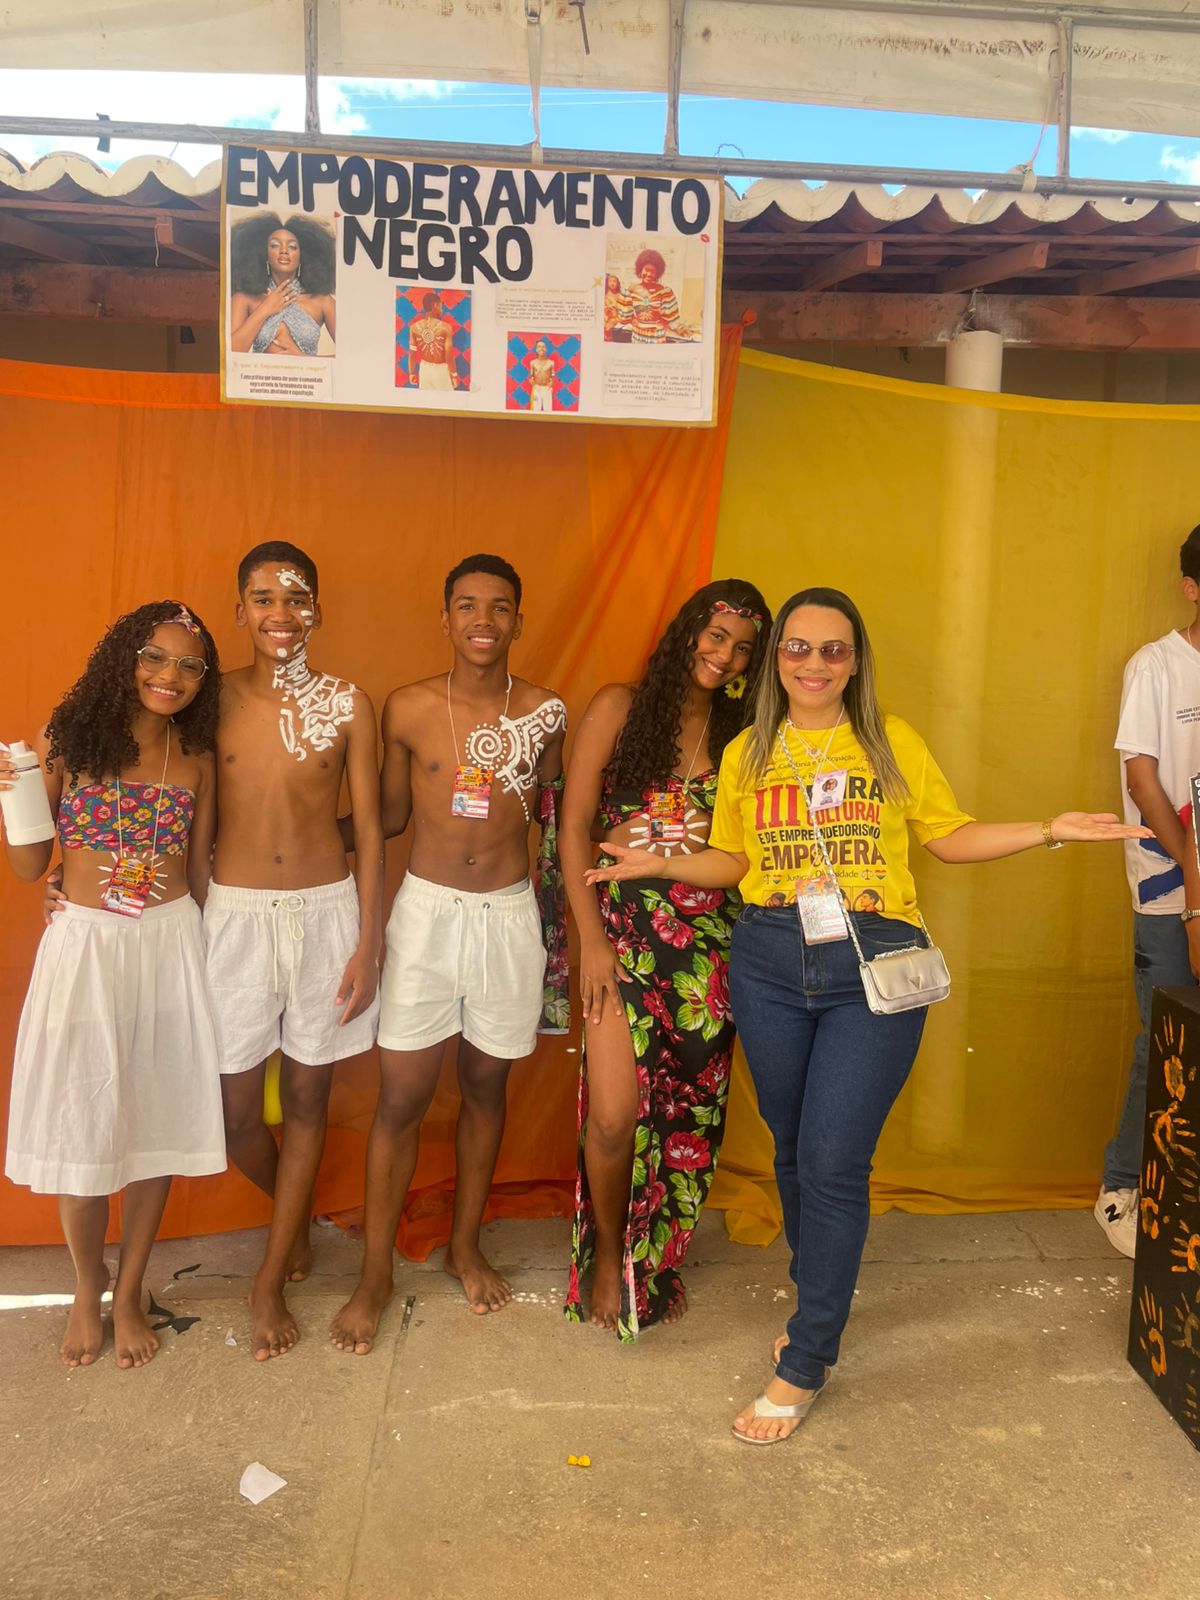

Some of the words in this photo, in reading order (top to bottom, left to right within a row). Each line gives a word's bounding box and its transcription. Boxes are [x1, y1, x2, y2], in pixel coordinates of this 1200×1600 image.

[226, 144, 711, 236] EMPODERAMENTO
[343, 215, 533, 285] NEGRO
[755, 783, 801, 831] III
[760, 839, 887, 871] EMPODERA
[779, 823, 881, 842] EMPRENDEDORISMO
